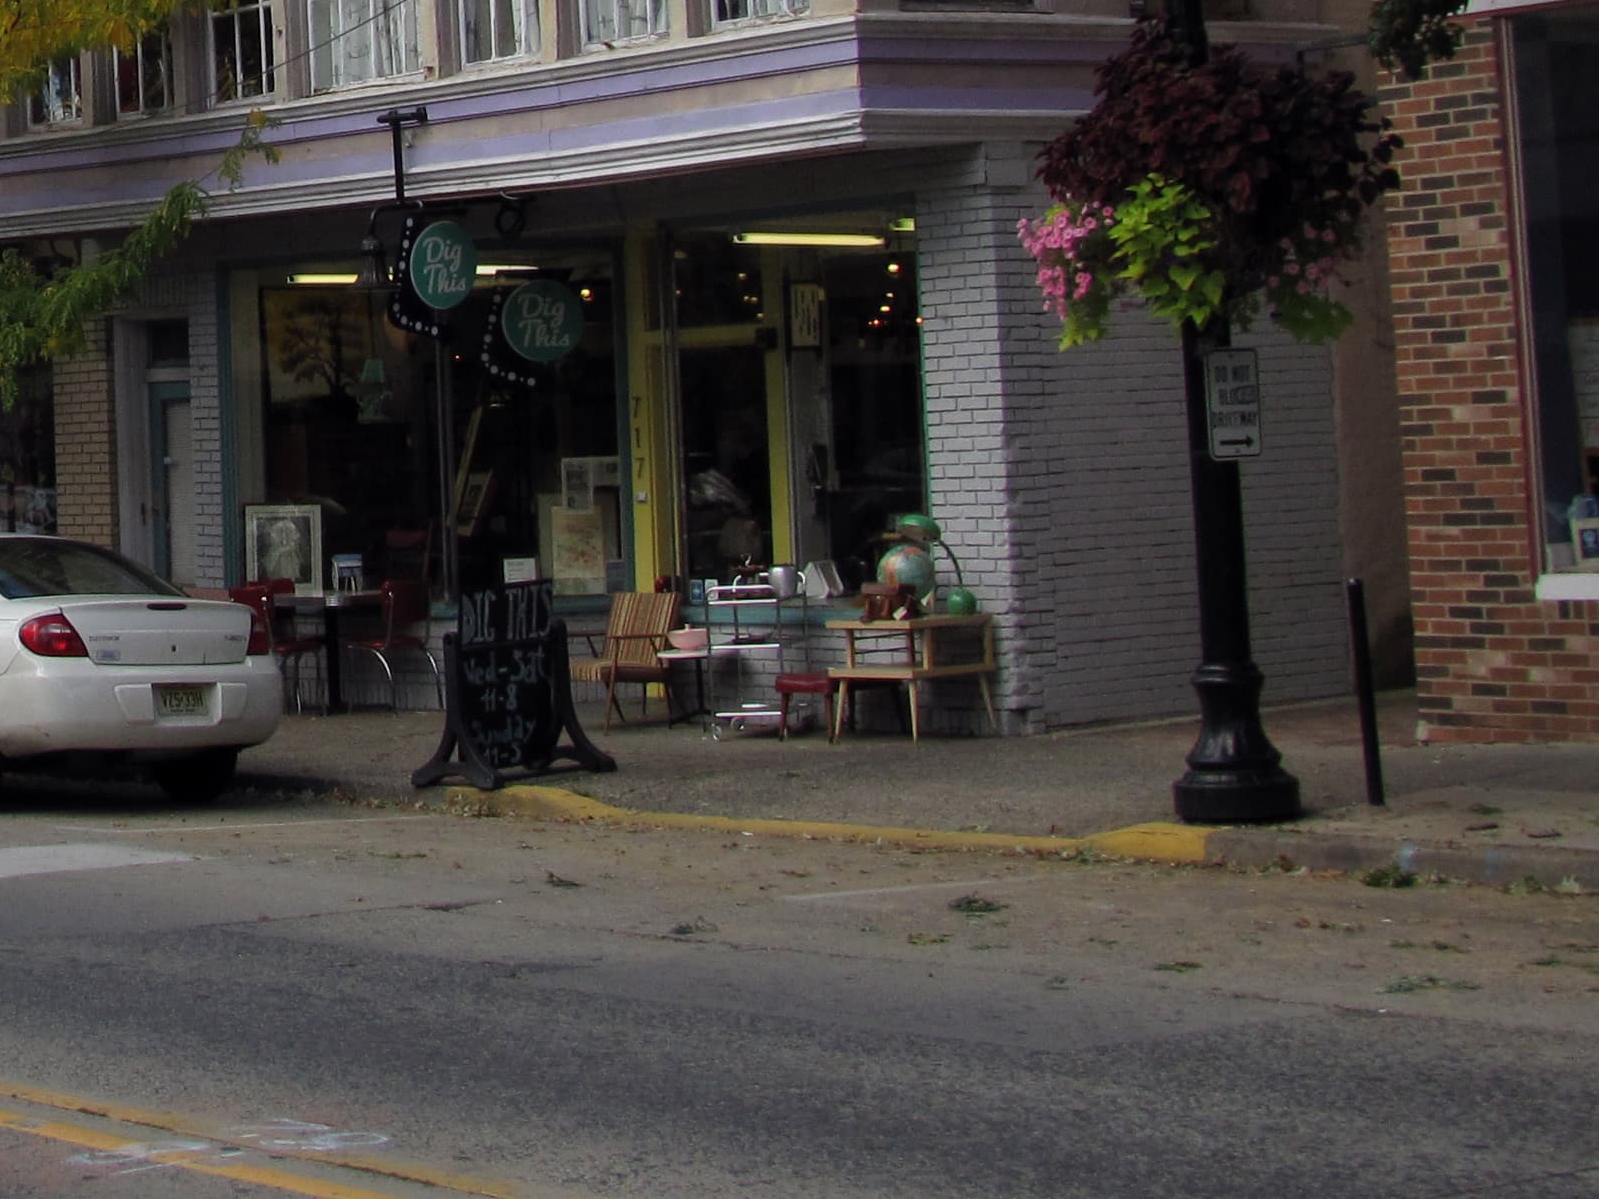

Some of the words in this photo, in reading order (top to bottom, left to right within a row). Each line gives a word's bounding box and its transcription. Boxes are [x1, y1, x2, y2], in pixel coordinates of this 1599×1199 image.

[422, 236, 463, 274] Dig
[423, 263, 467, 294] This
[518, 293, 565, 328] Dig
[518, 318, 570, 347] This
[1214, 365, 1228, 383] DO
[1232, 364, 1250, 382] NOT
[506, 582, 552, 641] THIS
